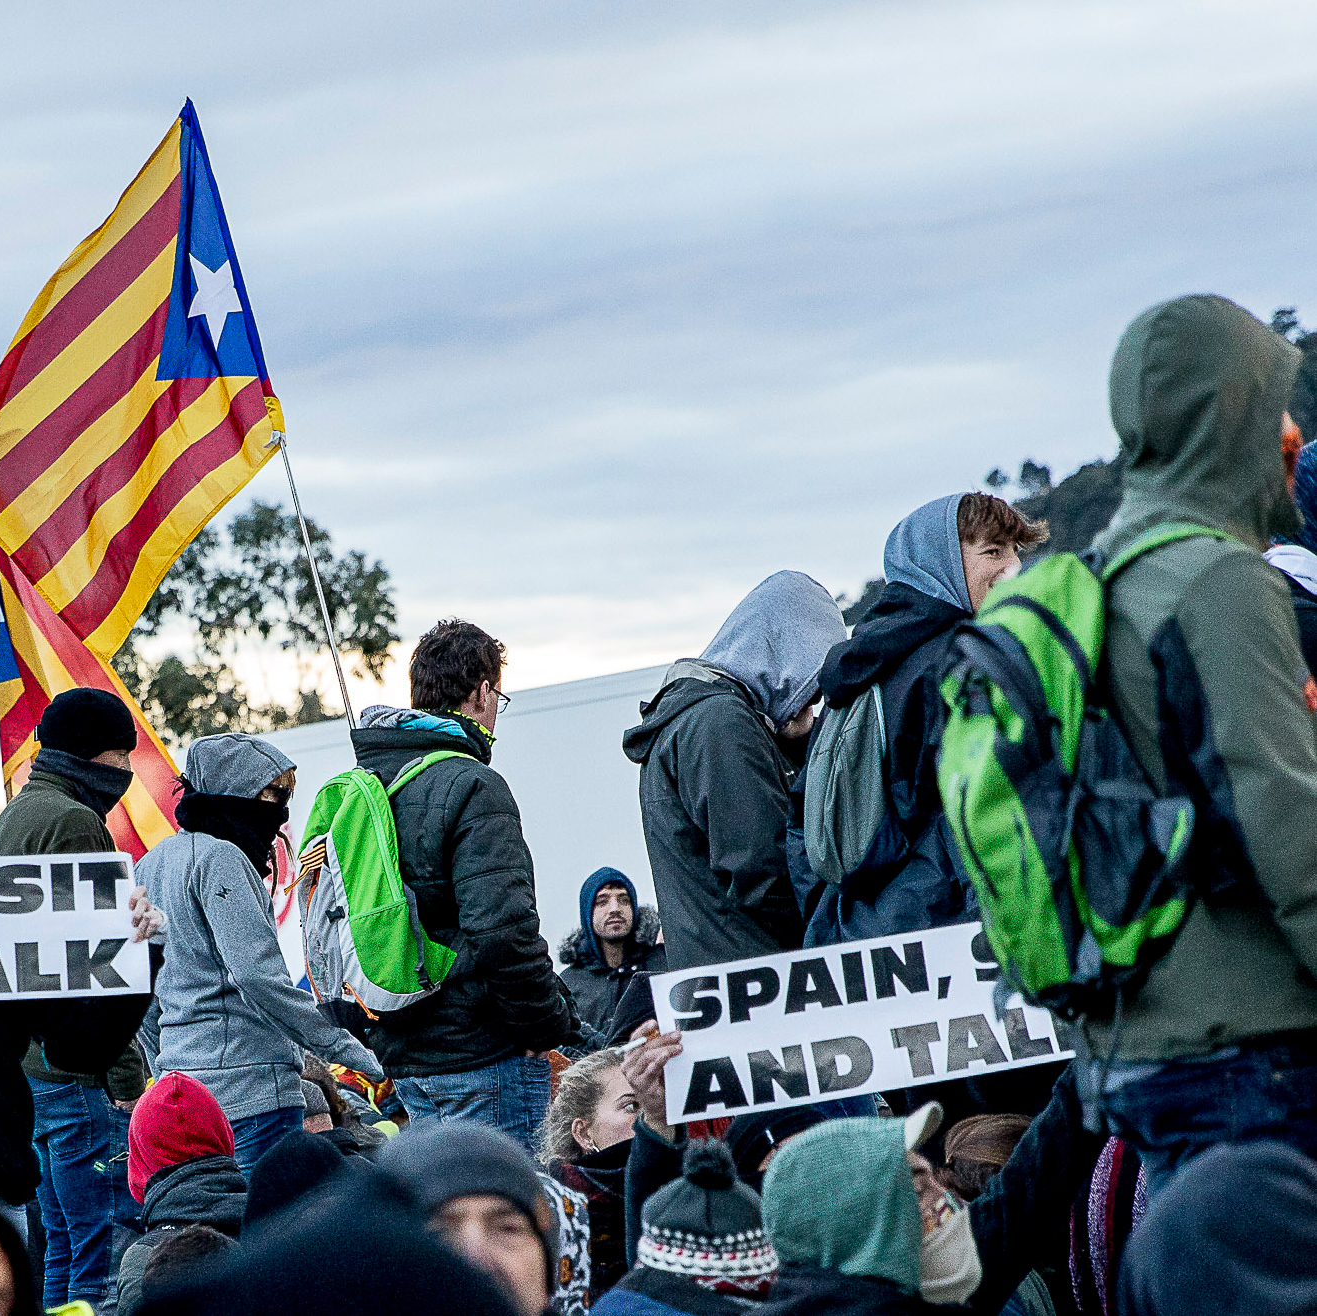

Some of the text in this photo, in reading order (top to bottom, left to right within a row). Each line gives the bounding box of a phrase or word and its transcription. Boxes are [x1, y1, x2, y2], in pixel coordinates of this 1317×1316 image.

[669, 941, 952, 1032] SPAIN,
[682, 1006, 1067, 1117] AND TAL
